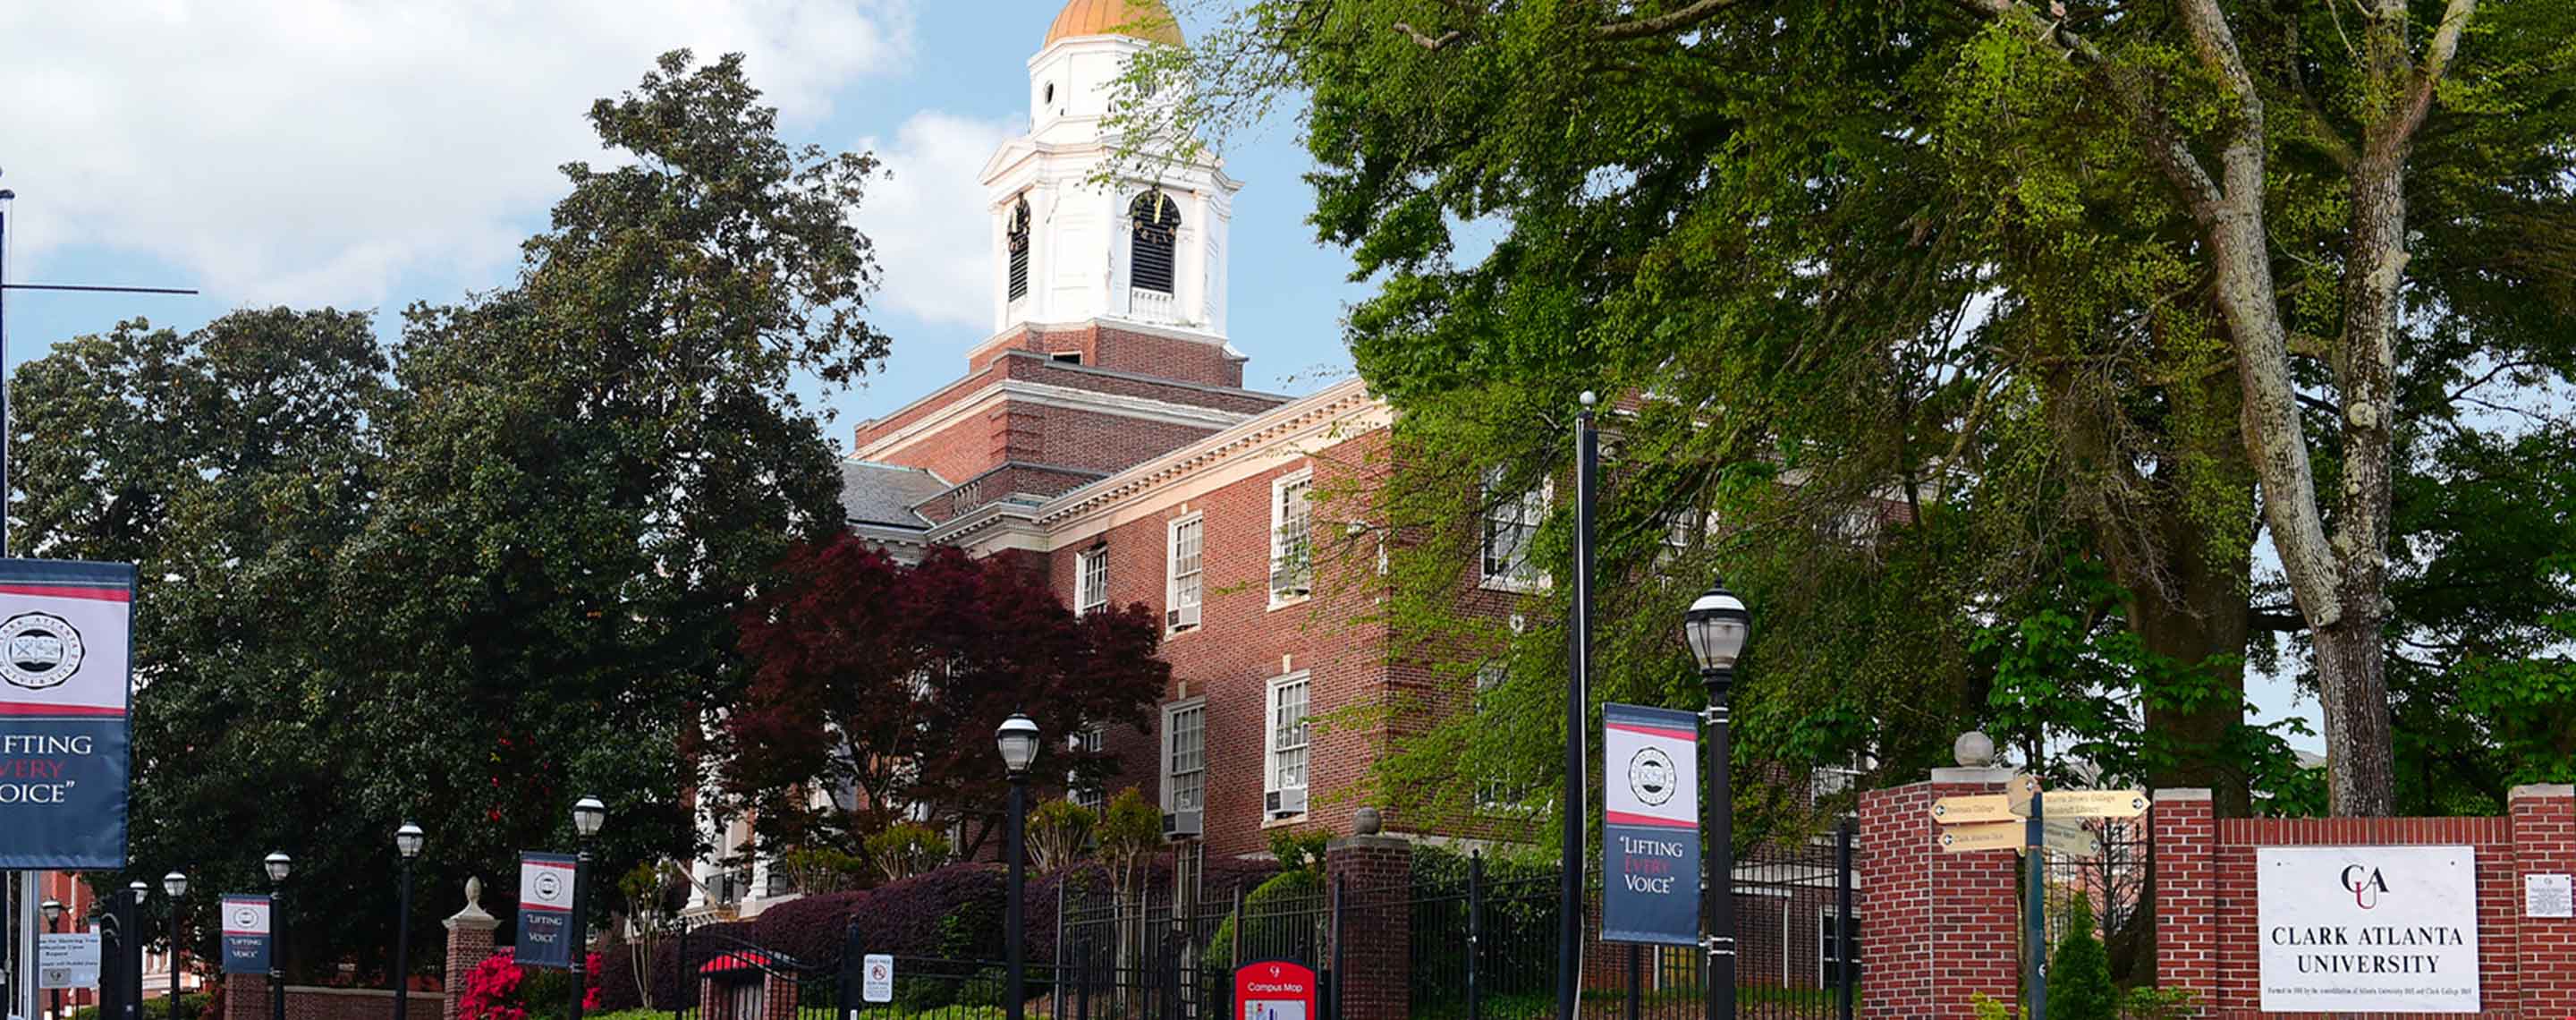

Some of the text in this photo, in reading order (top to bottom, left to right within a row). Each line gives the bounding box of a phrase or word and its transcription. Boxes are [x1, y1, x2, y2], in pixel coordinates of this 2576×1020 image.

[1619, 835, 1683, 858] “LIFTING
[1624, 854, 1672, 875] EVERY
[1624, 874, 1675, 895] VOICE”
[2271, 926, 2463, 946] CLARK ATLANTA
[2297, 955, 2440, 973] UNIVERSITY
[1248, 982, 1302, 994] Campus Map
